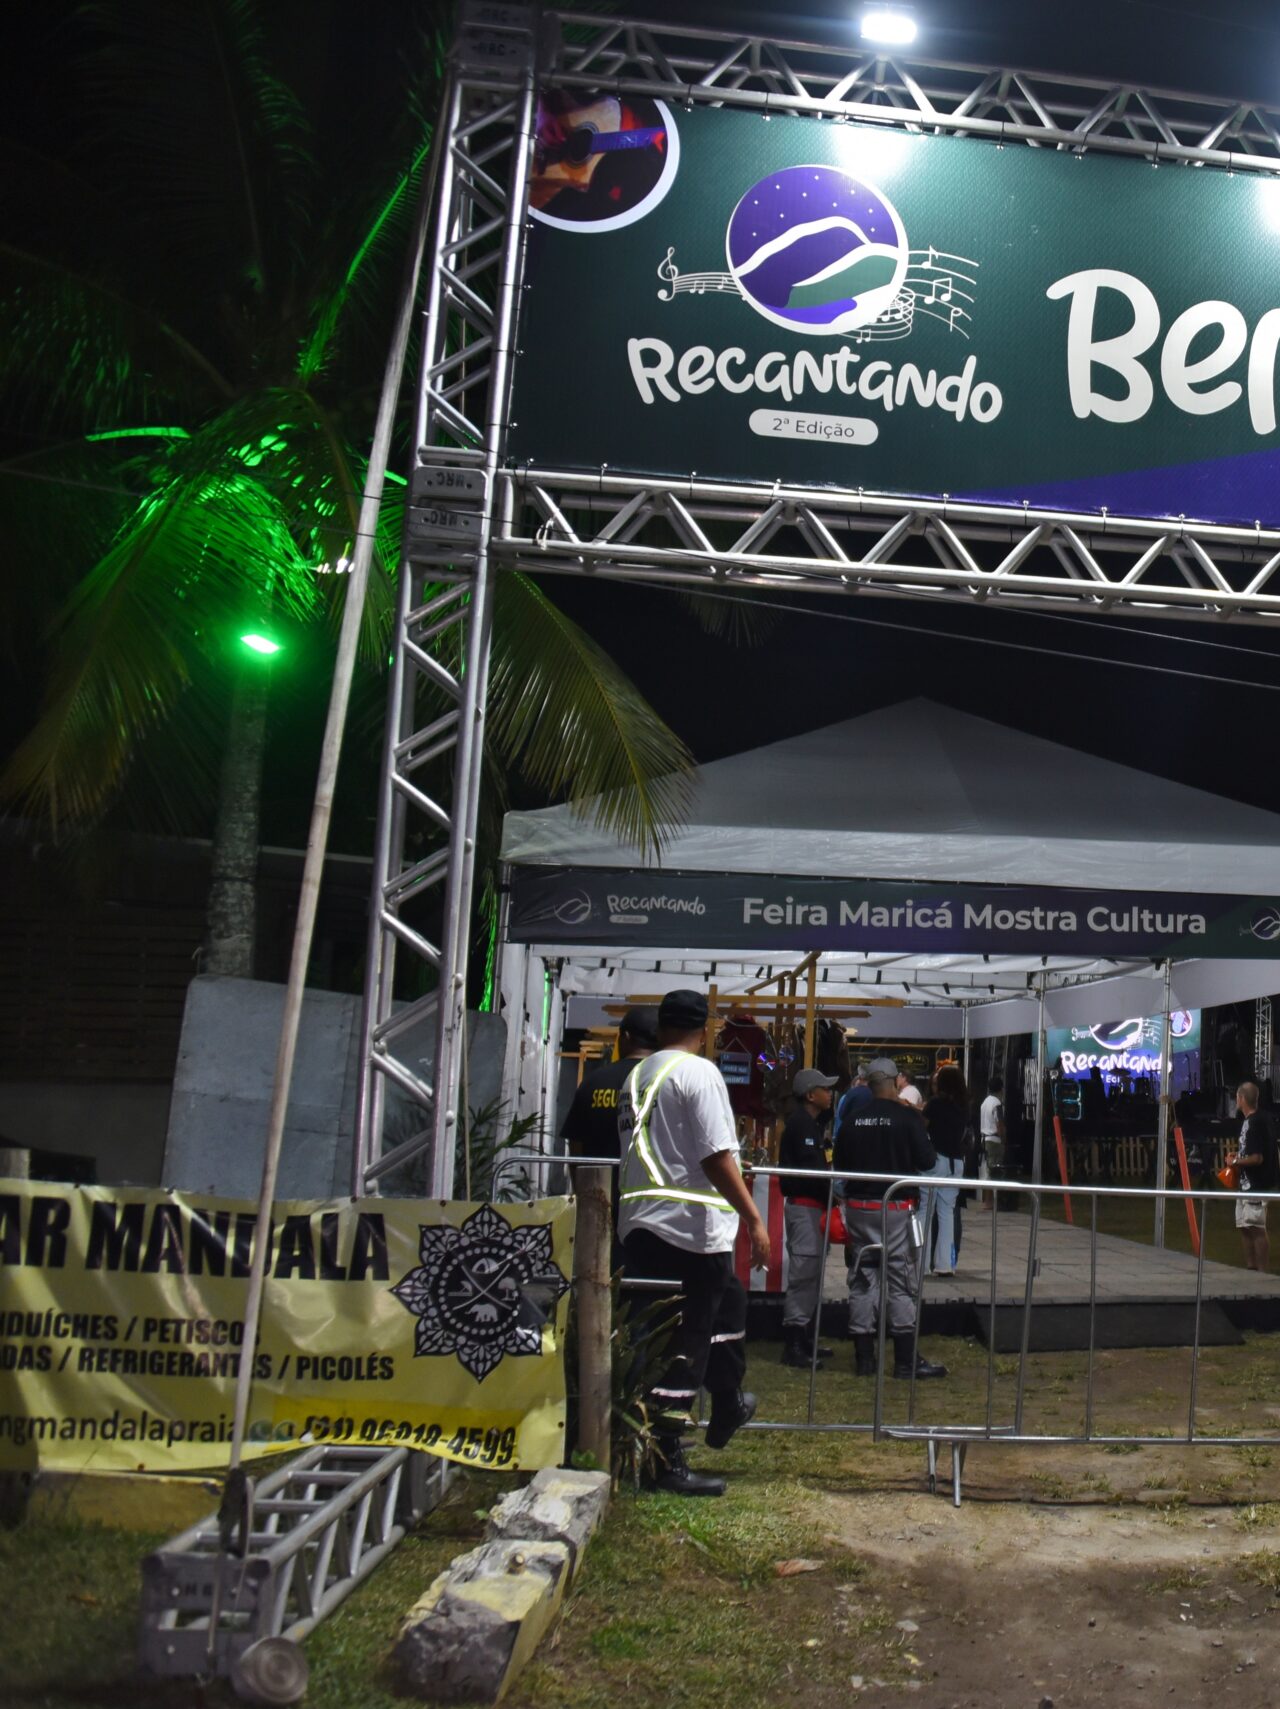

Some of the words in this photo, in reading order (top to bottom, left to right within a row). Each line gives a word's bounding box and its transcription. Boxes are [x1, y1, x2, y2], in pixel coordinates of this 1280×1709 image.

[627, 337, 1003, 423] Recantando
[795, 419, 855, 440] Edição
[607, 894, 706, 915] Recantando
[743, 897, 828, 926] Feira
[839, 899, 953, 929] Maricá
[964, 904, 1077, 932] Mostra
[1086, 906, 1207, 935] Cultura
[86, 1201, 390, 1282] MANDALA
[143, 1317, 261, 1347] PETISCO
[78, 1348, 272, 1380] REFRIGERANTS
[295, 1352, 394, 1381] PICOLÉS
